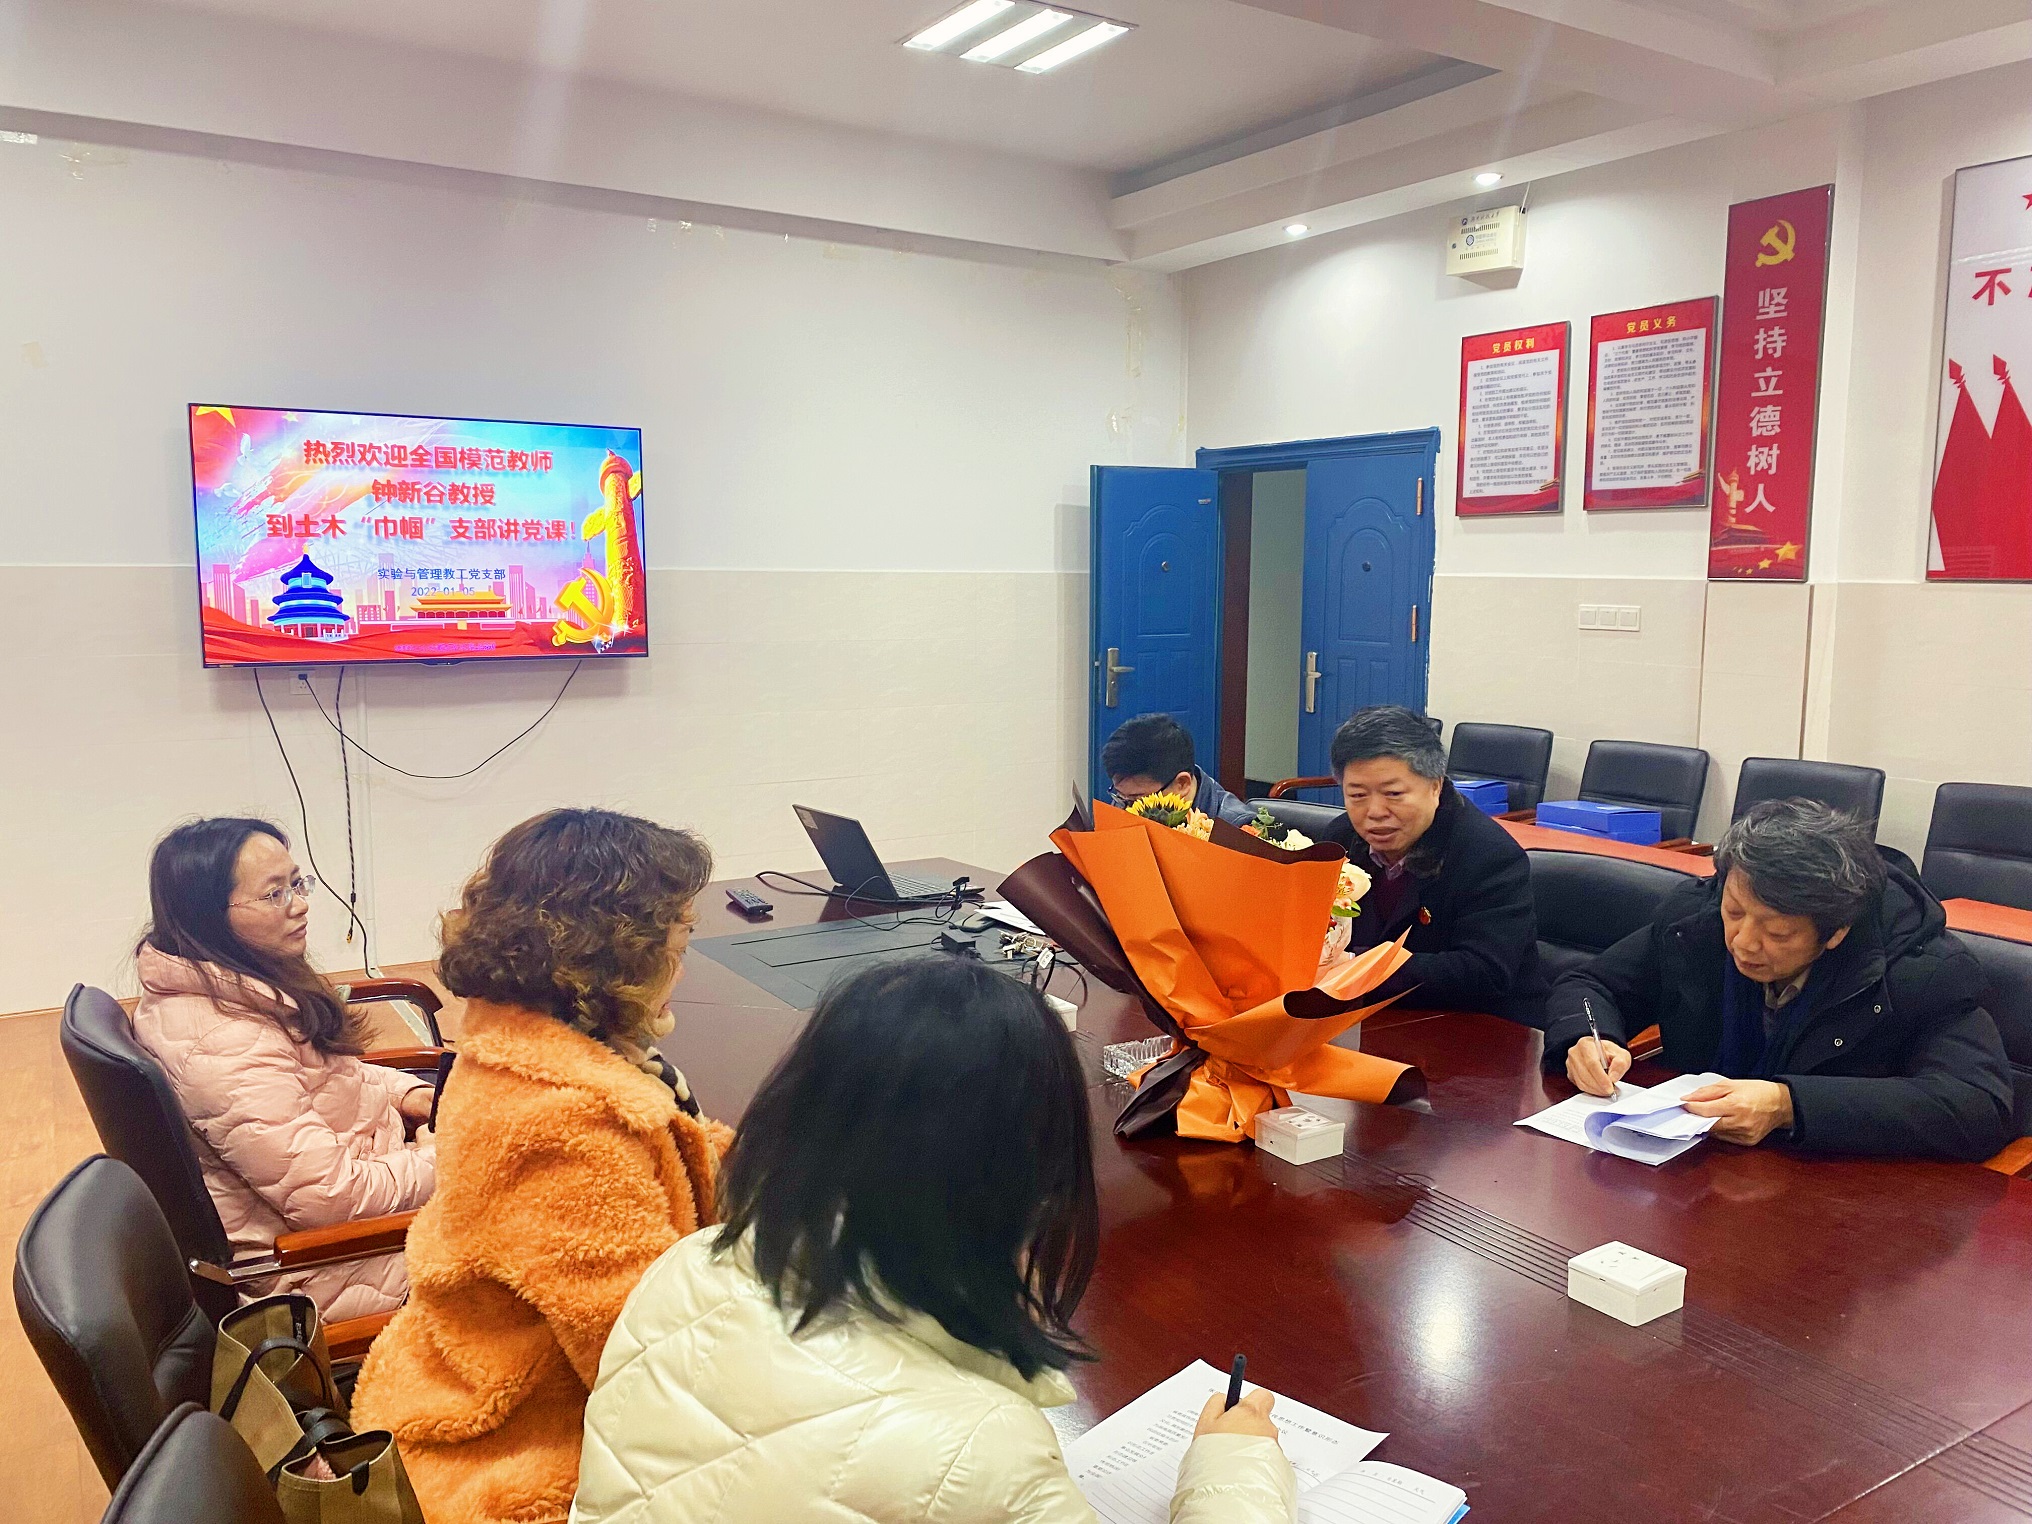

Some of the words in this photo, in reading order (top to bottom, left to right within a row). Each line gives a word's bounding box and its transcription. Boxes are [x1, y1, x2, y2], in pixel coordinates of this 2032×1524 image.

[1972, 266, 2032, 306] 不
[1626, 315, 1677, 334] 党员义务
[1491, 338, 1535, 354] 党员权利
[1744, 287, 1789, 513] 坚持立德树人
[303, 439, 554, 473] 热烈欢迎全国模范教师
[371, 479, 496, 506] 钟新谷教授
[377, 567, 506, 581] 实验与管理教工党支部
[411, 586, 476, 597] 2022-01-05
